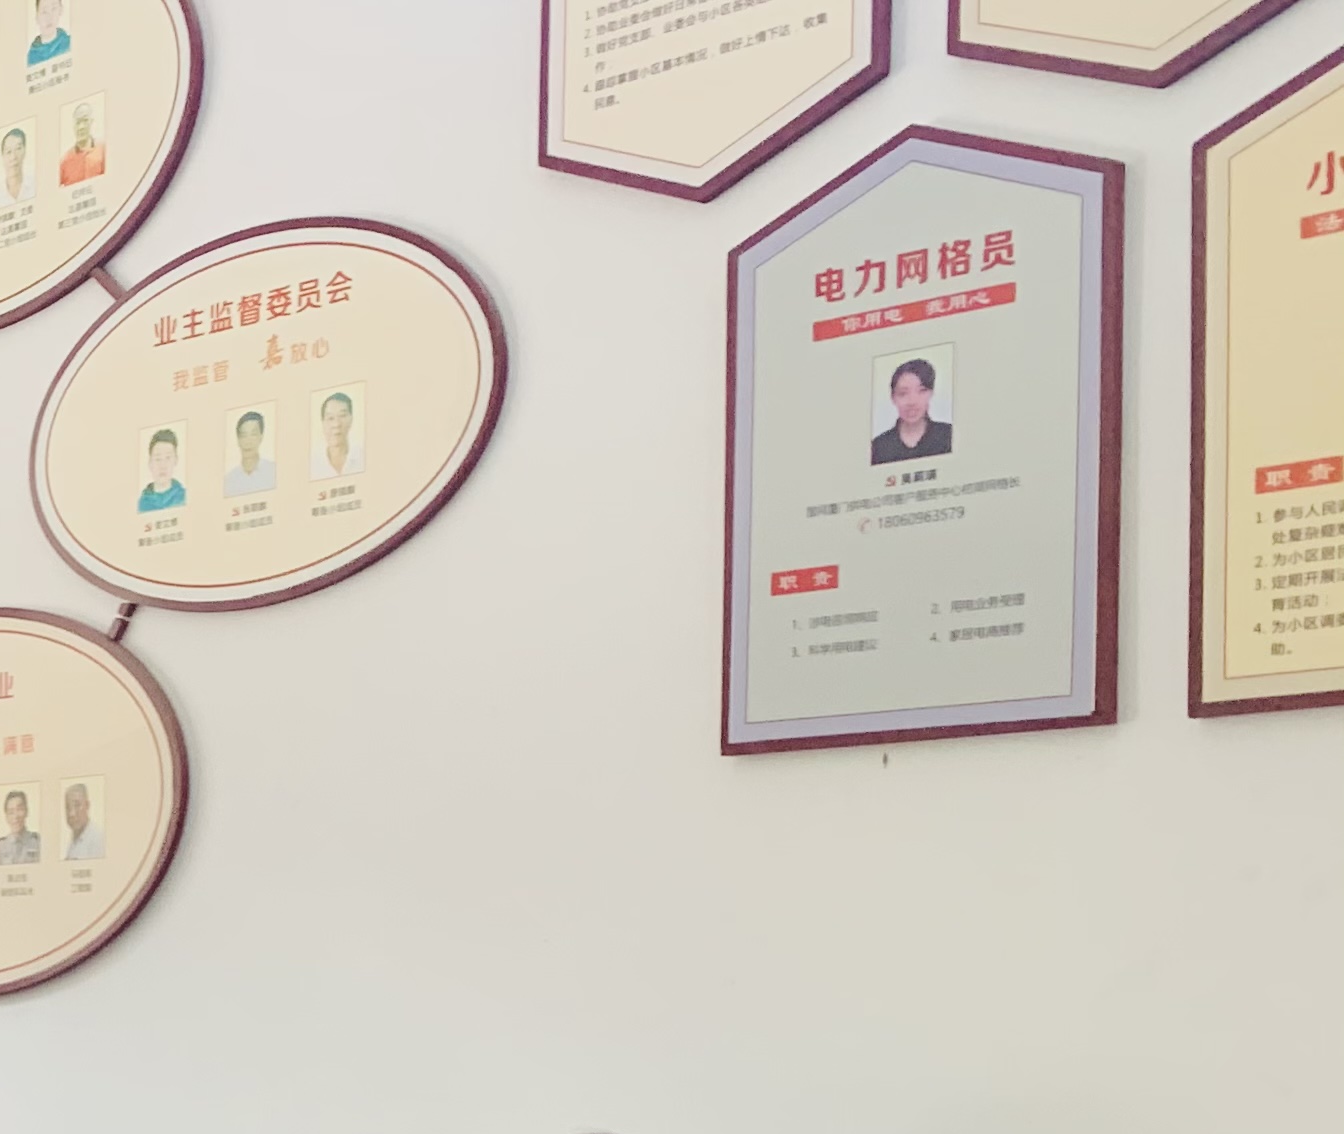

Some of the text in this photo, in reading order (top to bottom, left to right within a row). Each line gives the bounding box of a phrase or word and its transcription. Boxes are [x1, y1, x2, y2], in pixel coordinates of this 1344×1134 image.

[814, 229, 1016, 303] 电力网格员
[153, 270, 354, 347] 业主监督委员会
[172, 359, 230, 391] 我监管
